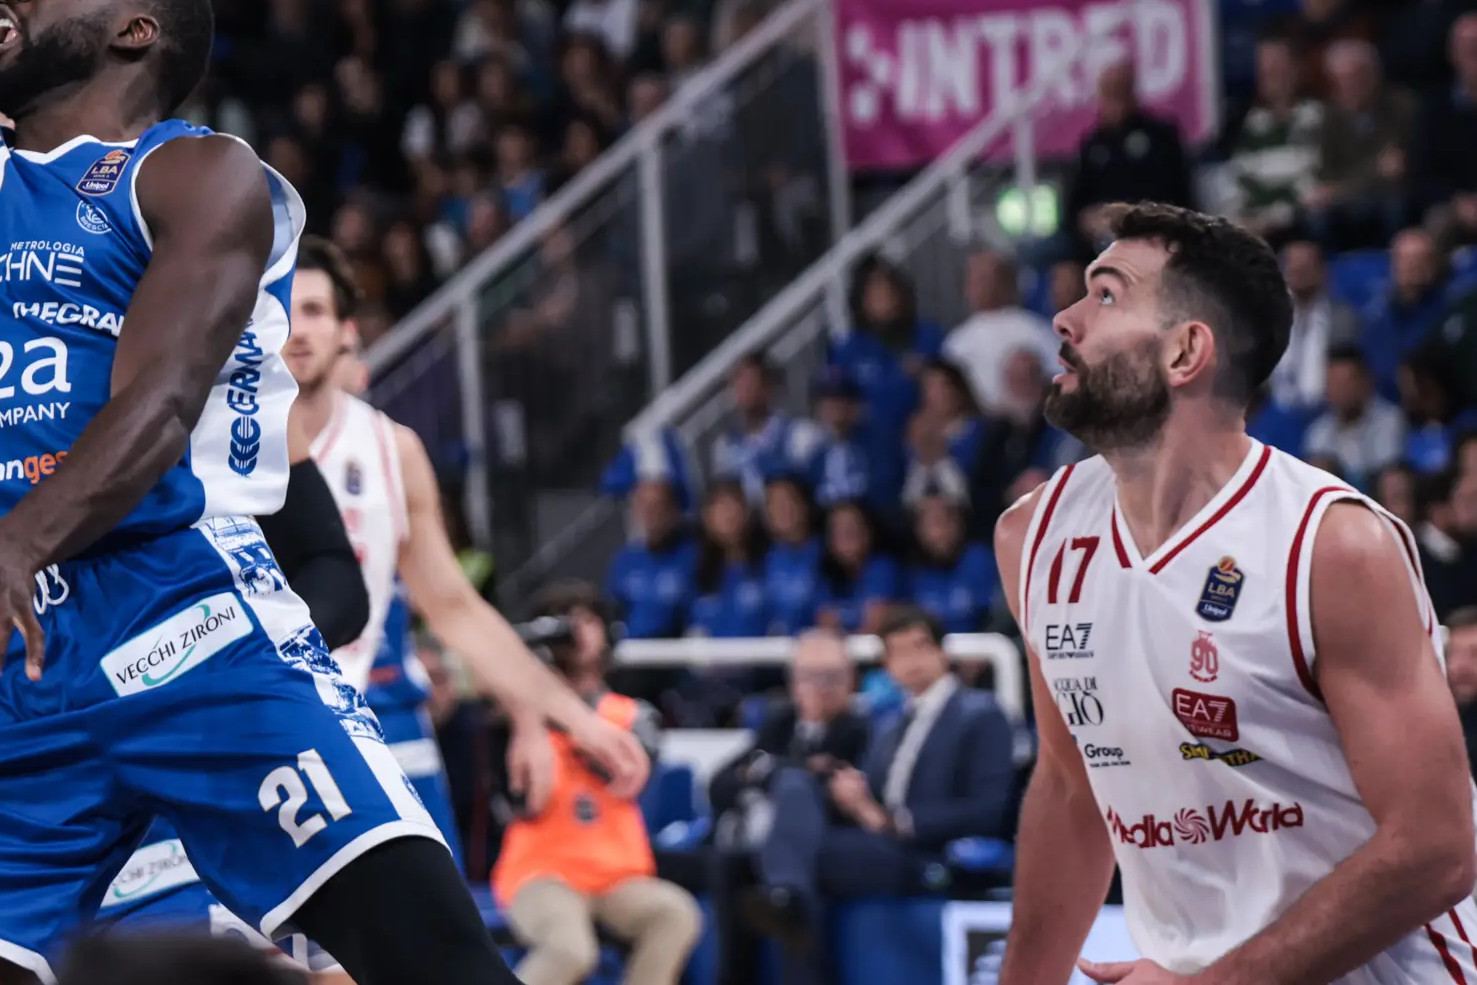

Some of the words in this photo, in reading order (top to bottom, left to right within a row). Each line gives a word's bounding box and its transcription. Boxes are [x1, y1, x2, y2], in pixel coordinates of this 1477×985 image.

[11, 240, 85, 257] METROLOGIA
[1047, 536, 1100, 604] 17
[1207, 581, 1236, 599] LBA
[115, 640, 175, 685] VECCHI
[179, 606, 236, 649] ZIRONI
[1045, 622, 1094, 651] EA7
[1175, 692, 1229, 723] EA7
[1084, 743, 1124, 760] Group
[257, 748, 352, 849] 21
